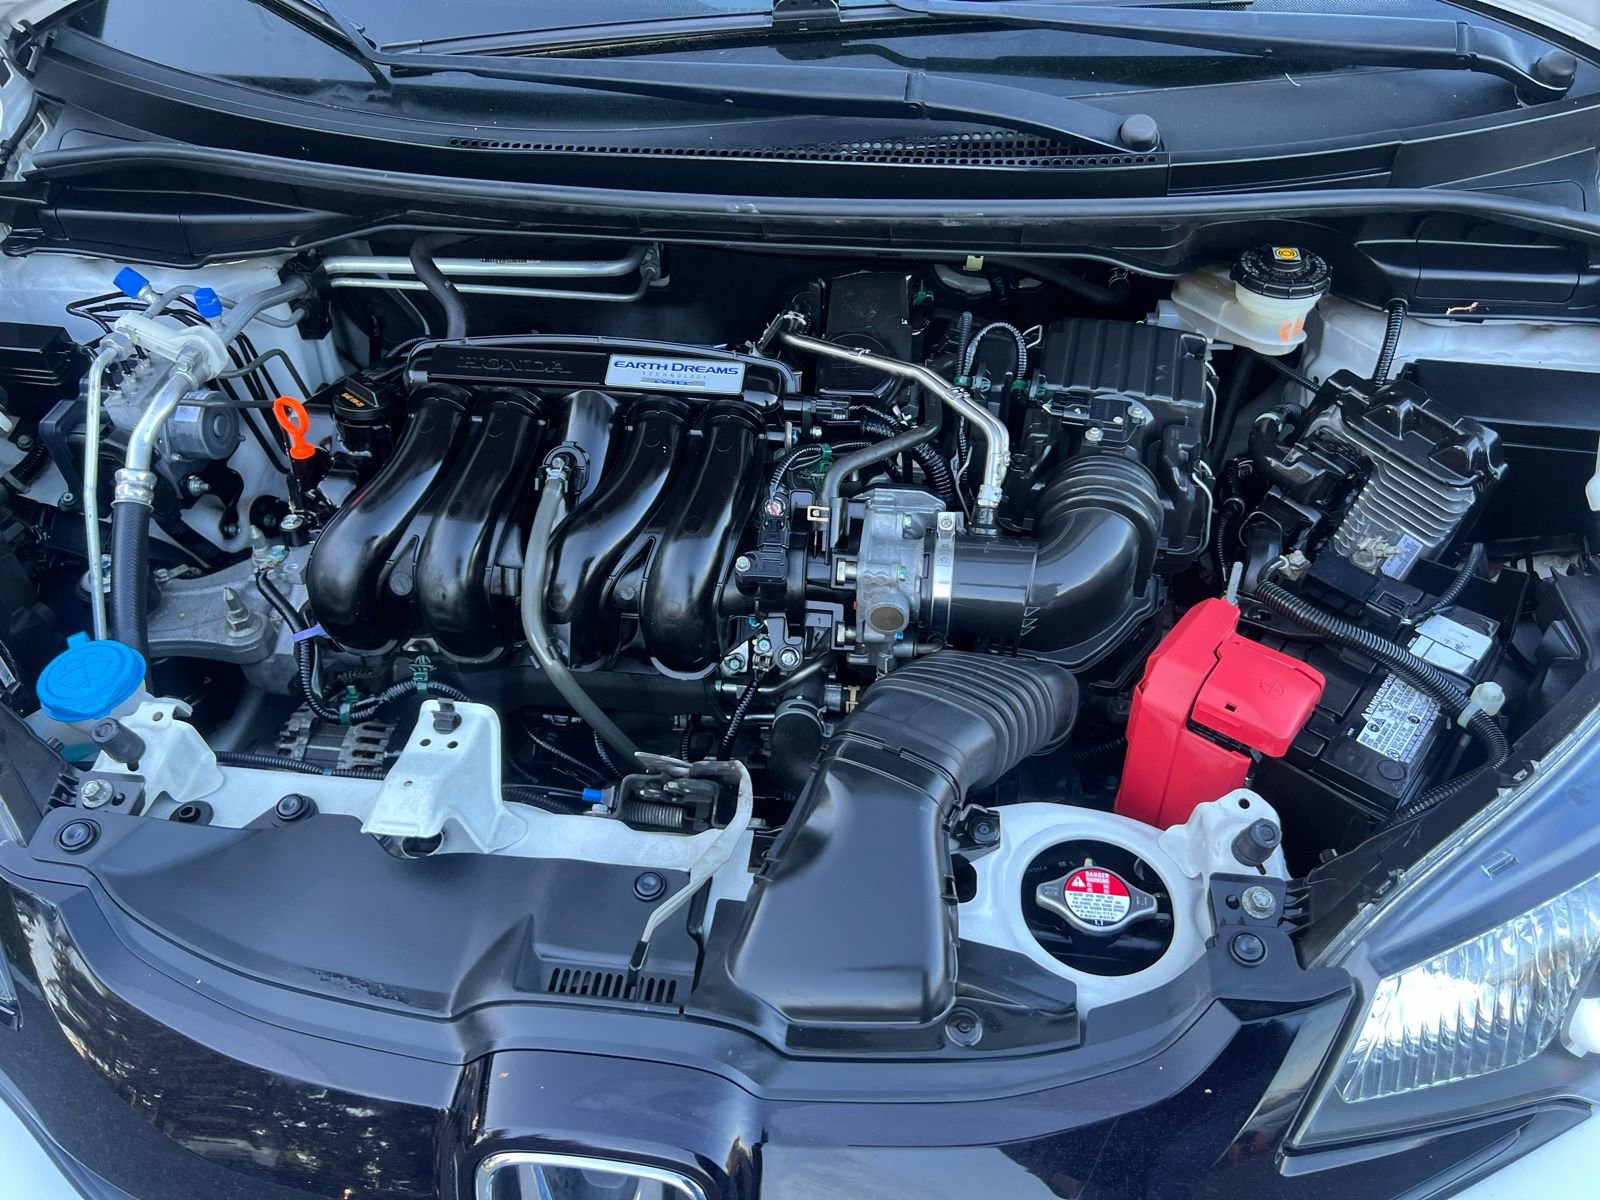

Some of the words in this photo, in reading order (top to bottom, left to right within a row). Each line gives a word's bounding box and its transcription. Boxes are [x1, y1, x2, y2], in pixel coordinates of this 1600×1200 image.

[613, 360, 668, 371] EARTH
[671, 363, 739, 375] DREAMS
[642, 371, 707, 380] TECHNOLOGY
[1364, 672, 1398, 717] DANGER/POIS
[1085, 870, 1110, 879] DANGER
